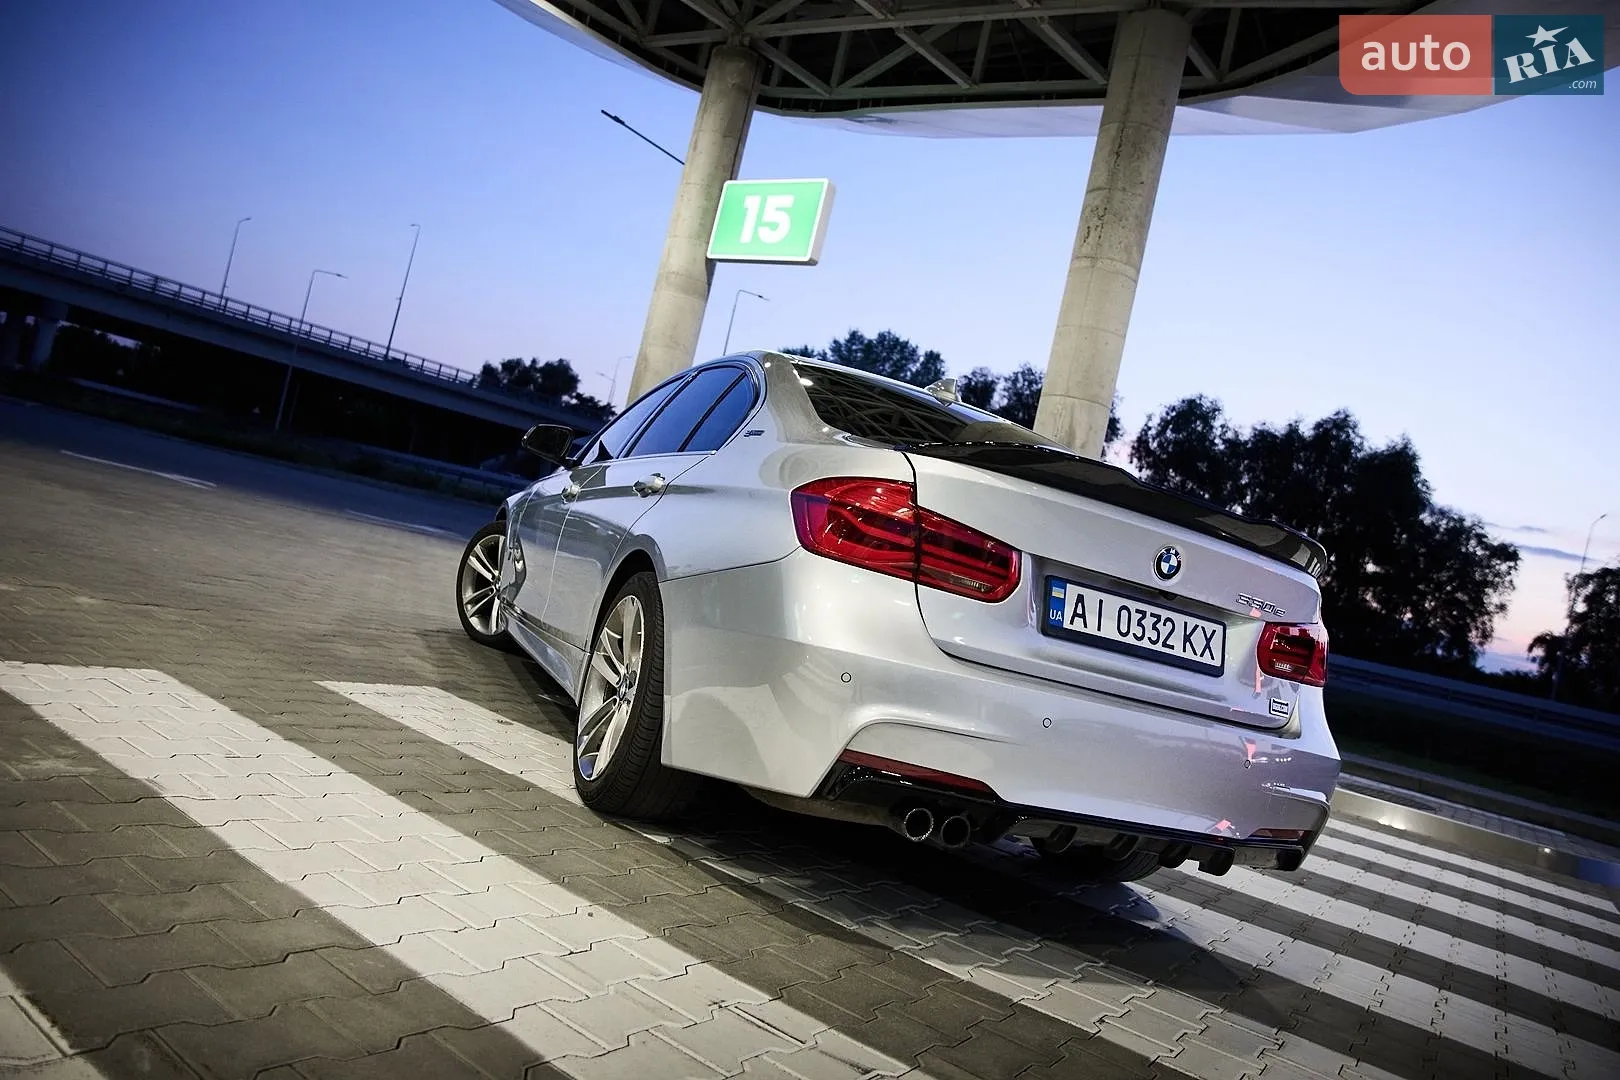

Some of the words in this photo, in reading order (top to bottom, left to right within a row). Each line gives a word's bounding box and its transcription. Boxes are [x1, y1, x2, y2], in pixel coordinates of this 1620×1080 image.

[739, 194, 795, 244] 15
[1049, 608, 1063, 622] UA
[1069, 594, 1104, 632] AI
[1116, 604, 1176, 651] 0332
[1182, 621, 1217, 660] KX
